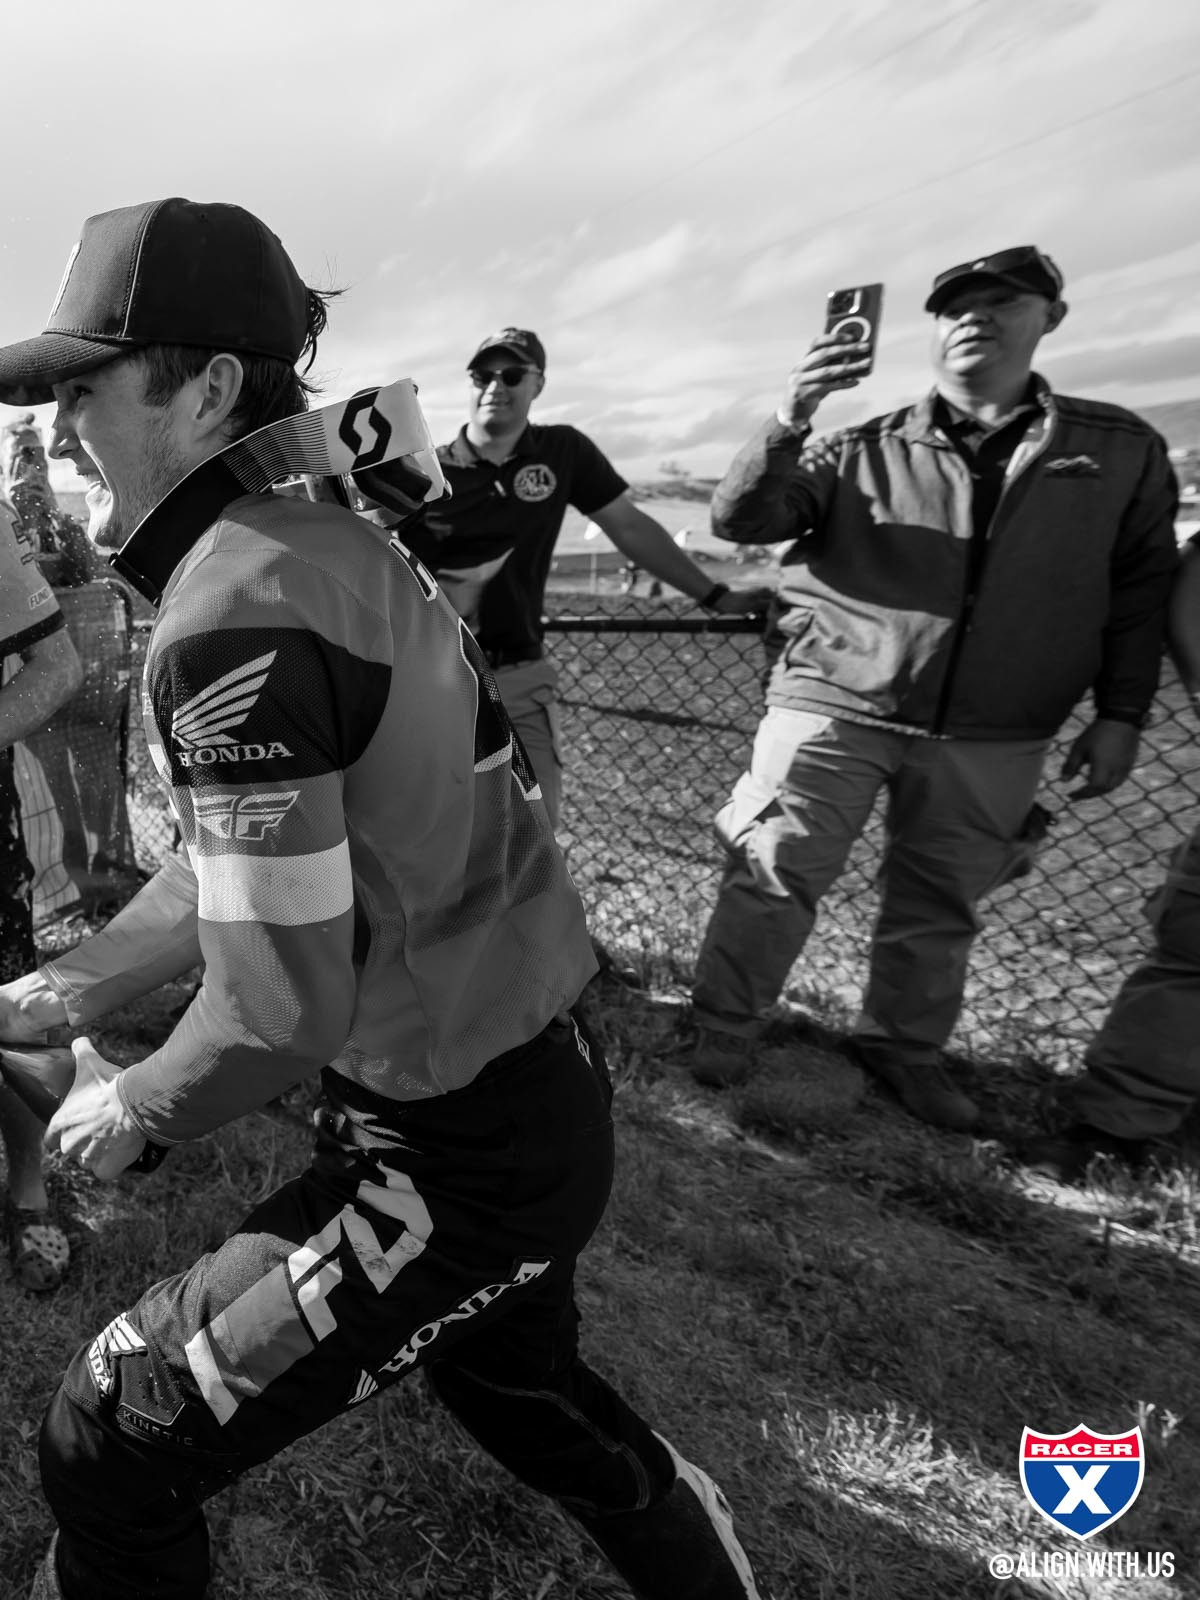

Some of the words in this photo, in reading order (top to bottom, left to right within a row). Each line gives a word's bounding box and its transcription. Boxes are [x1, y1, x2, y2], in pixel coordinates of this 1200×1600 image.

[175, 741, 295, 768] HONDA
[378, 1259, 552, 1375] HONDA
[122, 1409, 194, 1446] KINETIC
